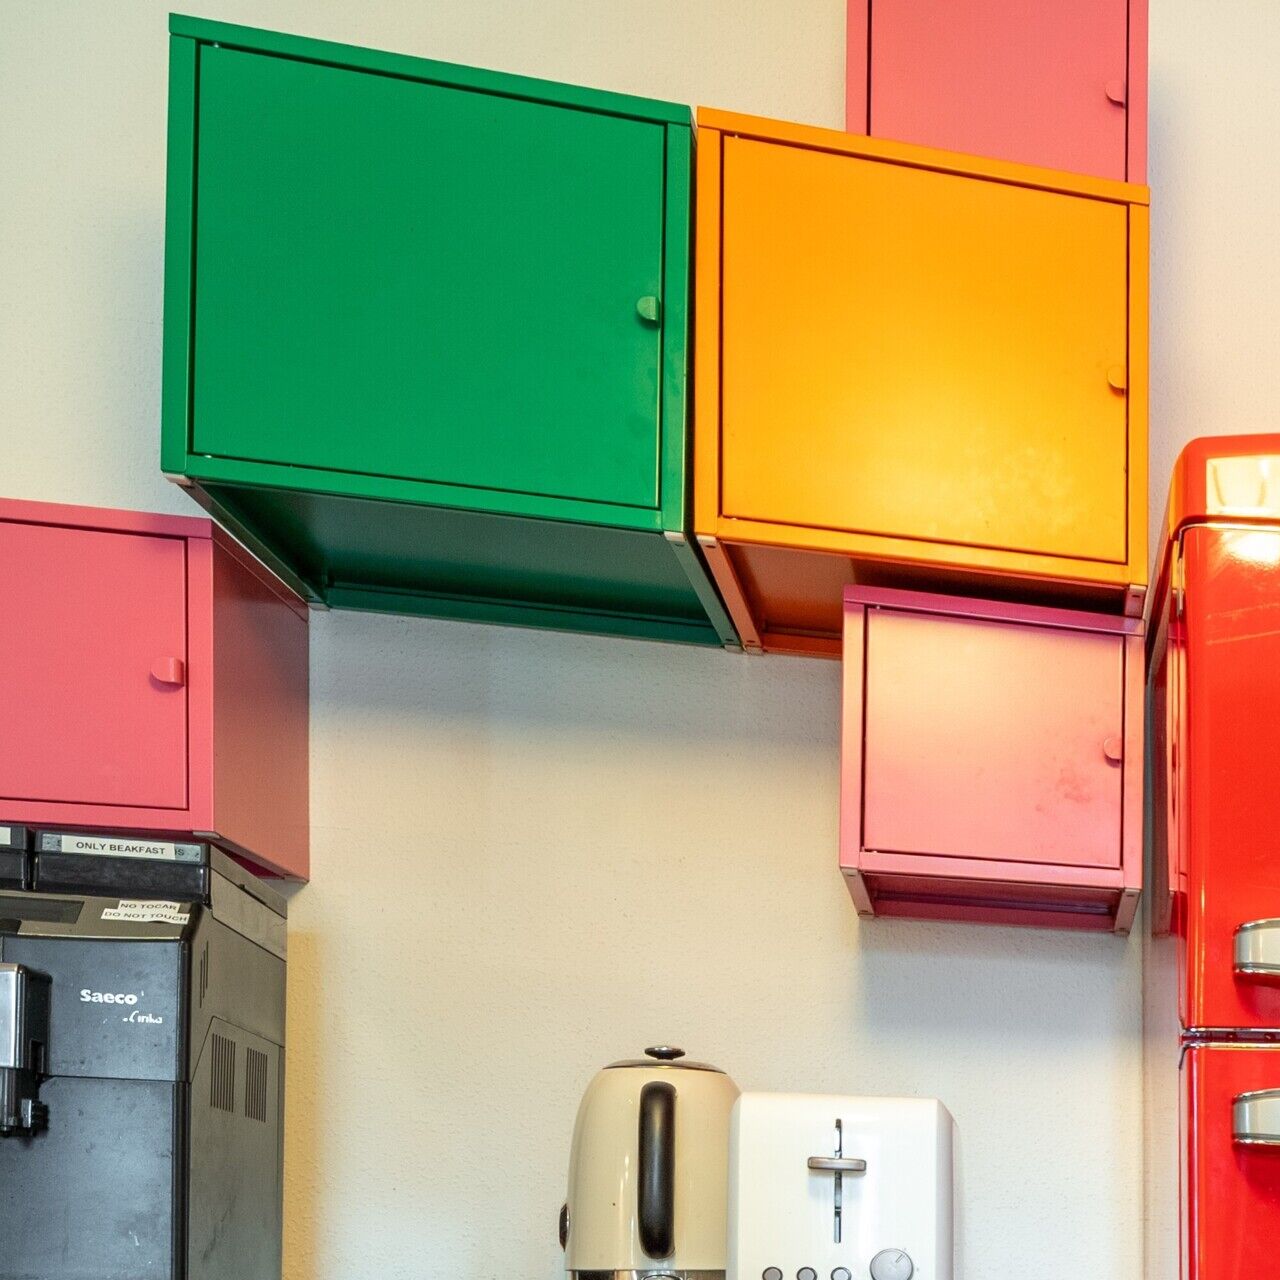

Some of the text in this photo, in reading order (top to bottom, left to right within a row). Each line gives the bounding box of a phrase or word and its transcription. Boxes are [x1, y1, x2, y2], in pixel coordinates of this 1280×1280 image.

[76, 841, 106, 850] ONLY
[109, 843, 166, 855] BEAKFAST
[120, 902, 177, 911] NO TOCAR
[149, 913, 188, 922] TOUCH
[80, 988, 138, 1005] Saeco
